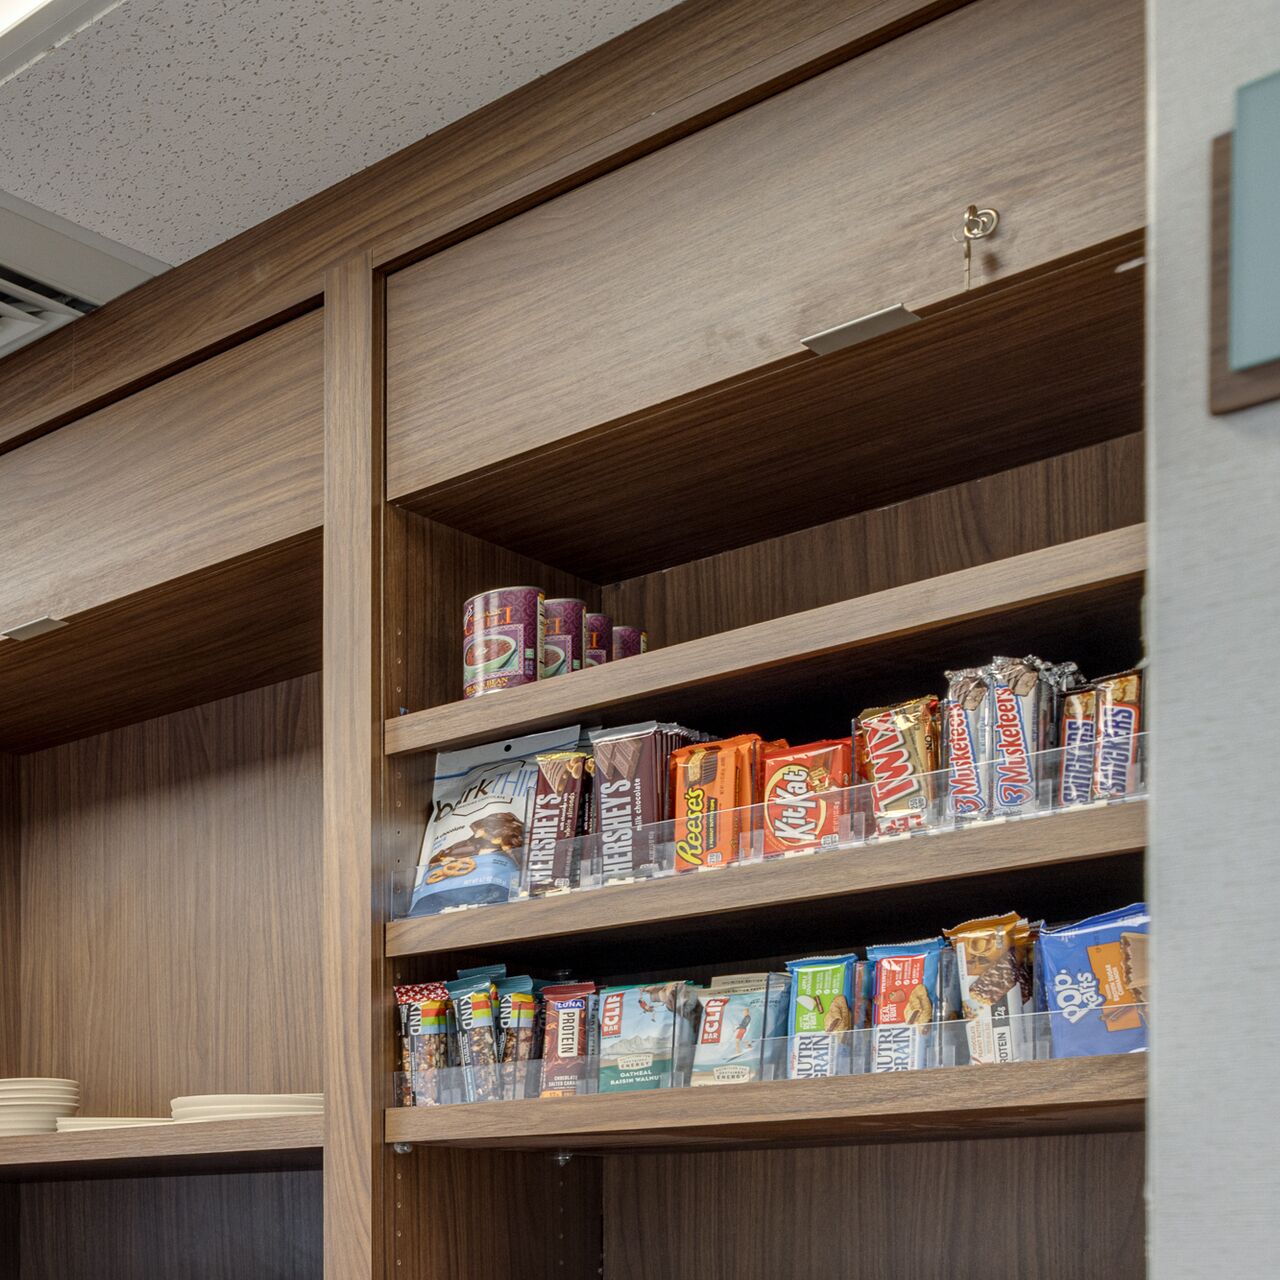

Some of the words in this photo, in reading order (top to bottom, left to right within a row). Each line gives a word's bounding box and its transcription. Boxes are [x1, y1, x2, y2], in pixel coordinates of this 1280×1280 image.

[948, 702, 978, 797] Musketeers
[994, 684, 1027, 783] Musketeers
[634, 777, 642, 814] chocolate
[529, 793, 561, 885] HERSHEY'S
[600, 779, 633, 876] HERSHEY'S
[675, 786, 705, 866] Reese's
[411, 1001, 422, 1036] KIND
[460, 991, 475, 1030] KIND
[500, 993, 512, 1028] KIND
[603, 993, 621, 1025] CLIF
[705, 998, 725, 1034] CLIF
[561, 1011, 576, 1054] PROTEIN
[610, 1077, 633, 1085] RAISIN
[620, 1060, 650, 1069] ENERGY
